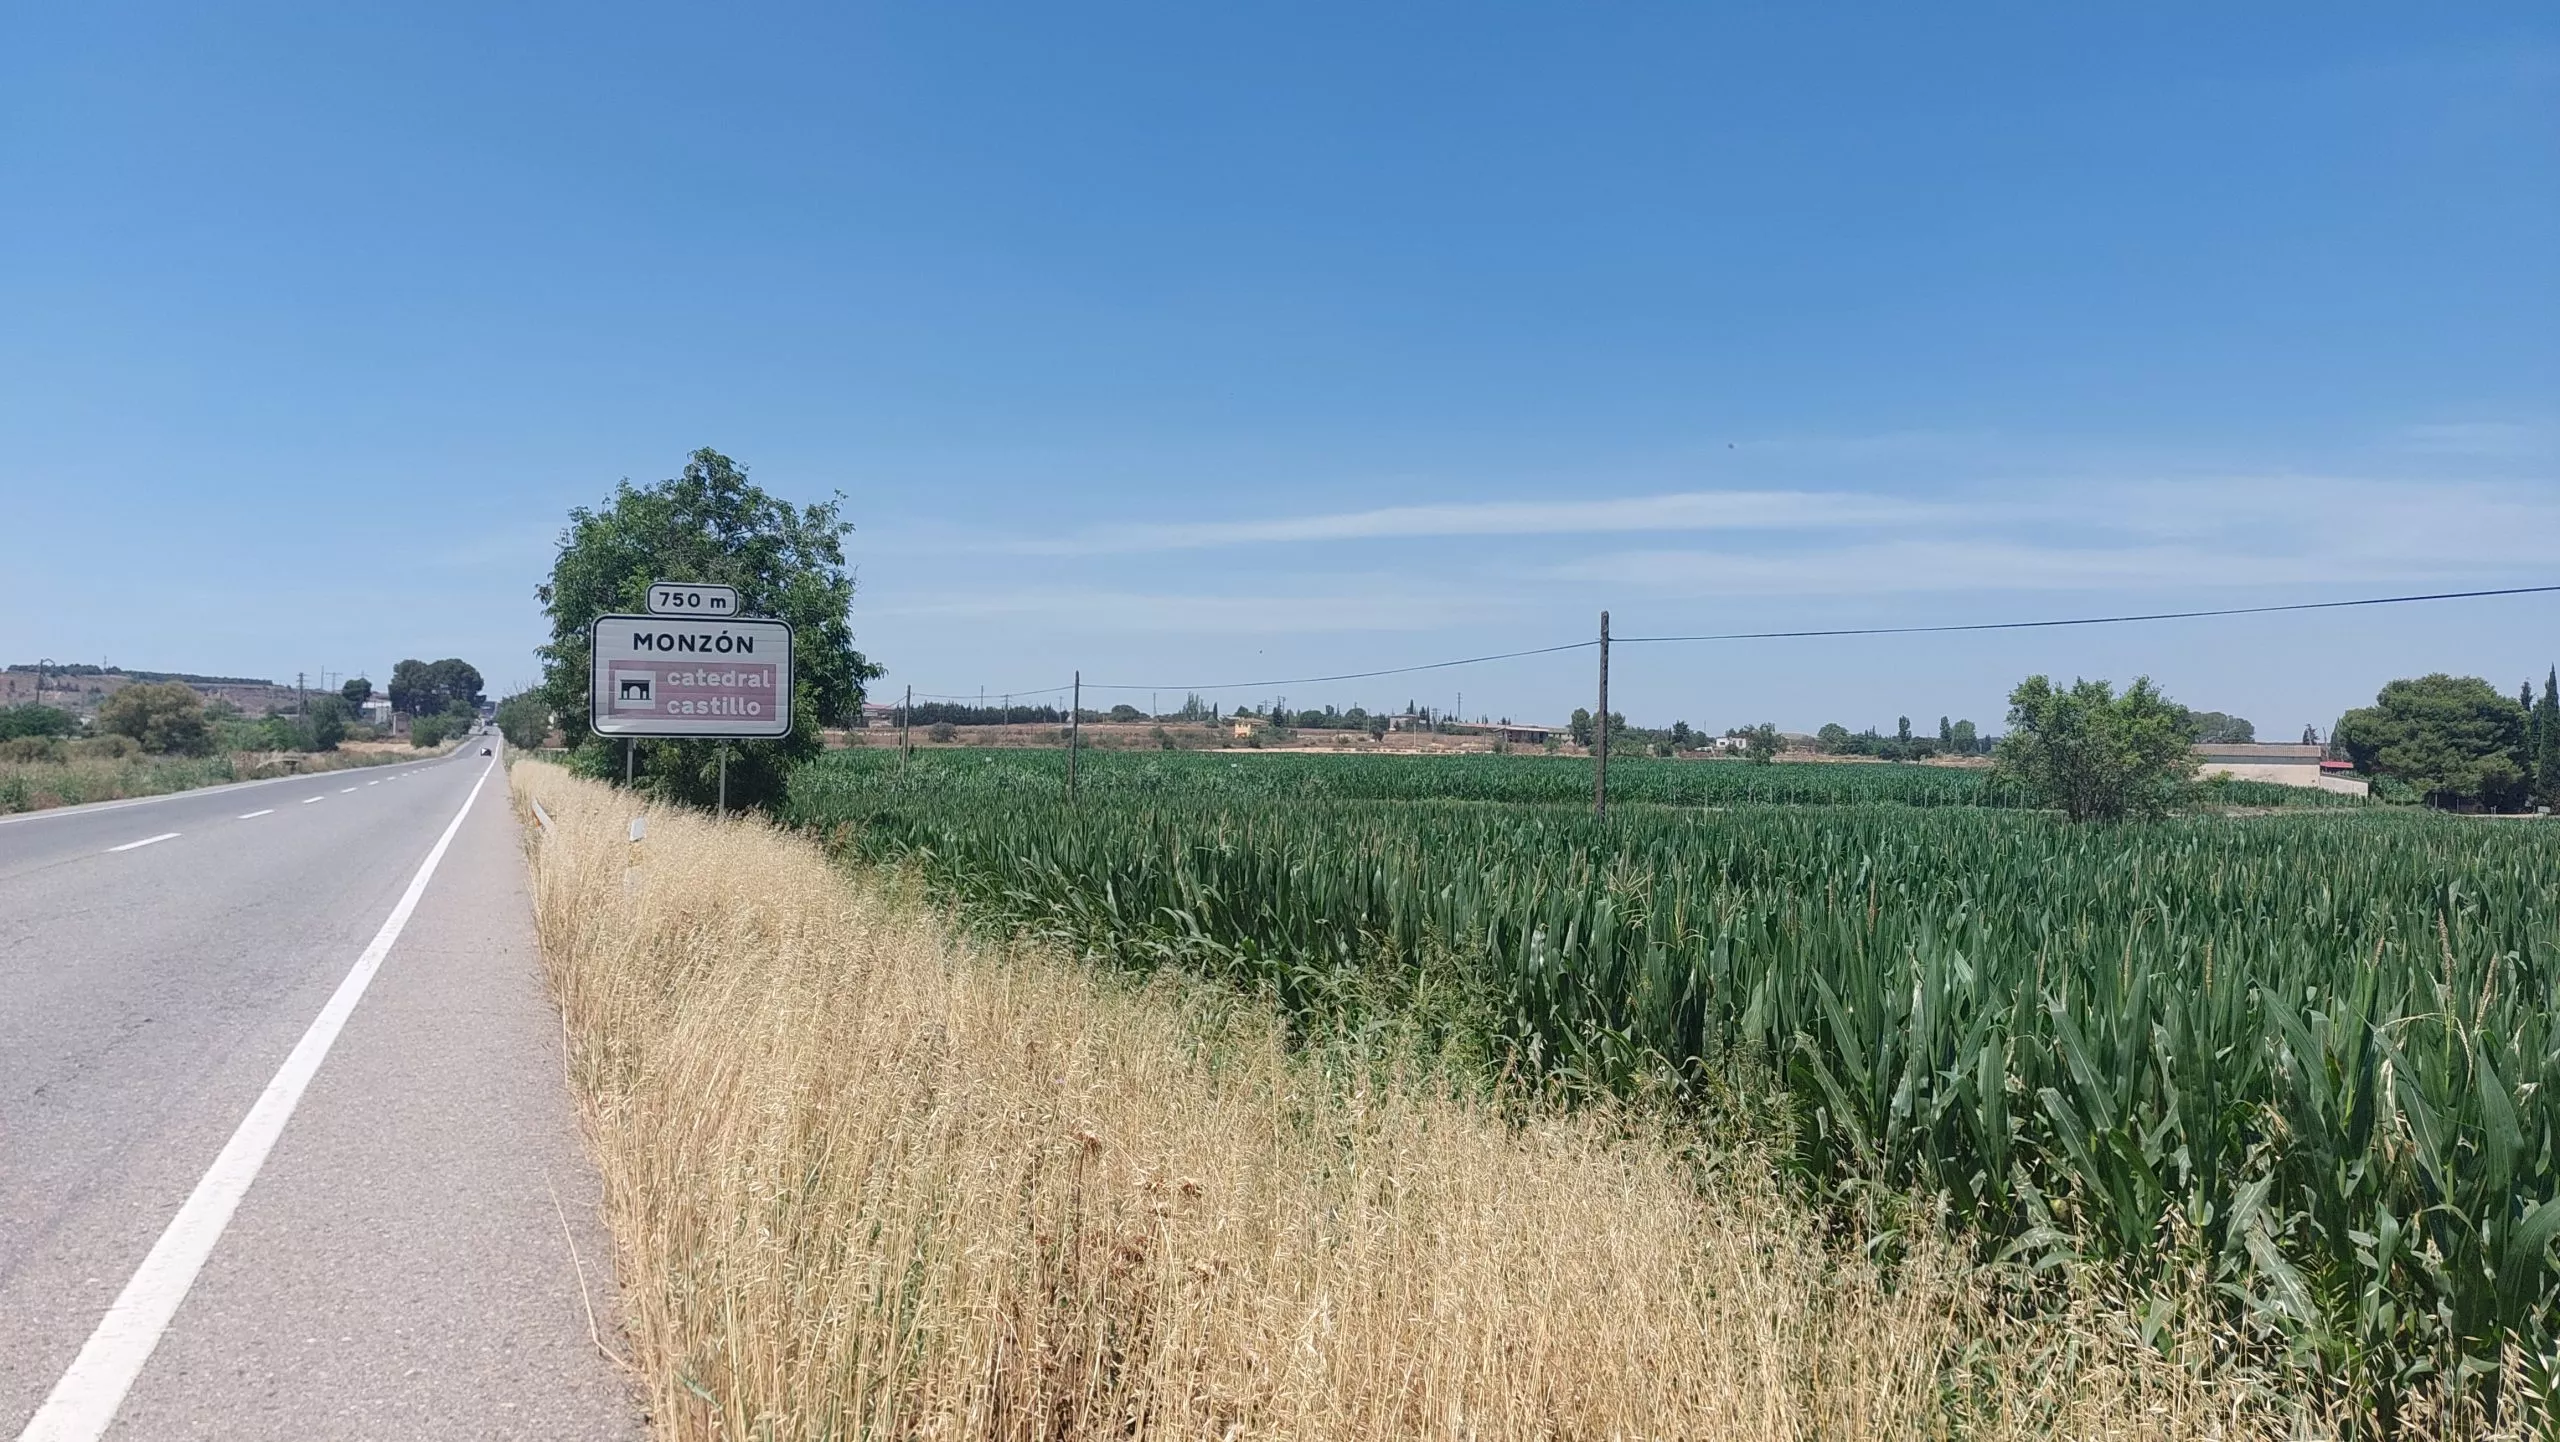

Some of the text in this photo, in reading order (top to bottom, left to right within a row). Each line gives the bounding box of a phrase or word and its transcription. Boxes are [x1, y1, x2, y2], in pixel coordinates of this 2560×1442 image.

[659, 592, 726, 608] 750 m
[633, 630, 754, 654] MONZÓN
[667, 668, 770, 688] catedral
[667, 696, 761, 716] castillo
